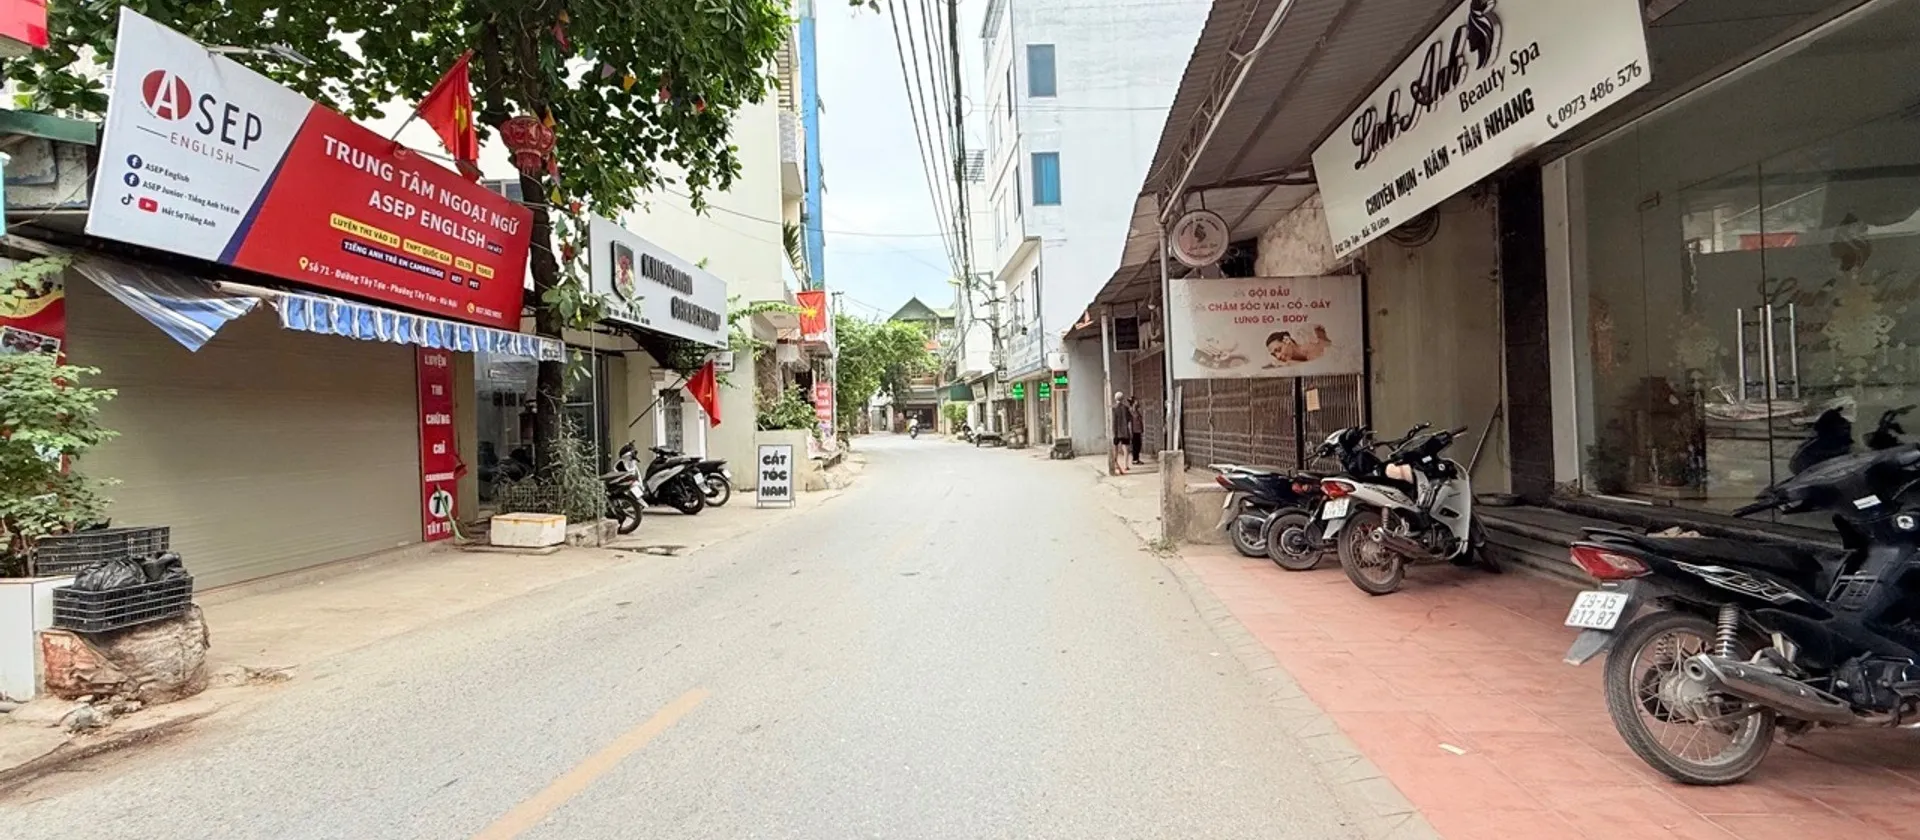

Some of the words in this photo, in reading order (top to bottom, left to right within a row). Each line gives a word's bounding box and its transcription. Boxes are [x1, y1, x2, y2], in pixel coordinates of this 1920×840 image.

[1459, 65, 1506, 113] Beauty
[1509, 41, 1541, 76] Spa
[1558, 94, 1587, 122] 0973
[1589, 77, 1614, 102] 486
[1617, 59, 1642, 87] 576
[142, 69, 263, 150] ASEP
[1351, 88, 1400, 170] Linh
[1400, 24, 1469, 132] Anh
[170, 132, 235, 165] ENGLISH
[1365, 182, 1396, 215] CHUYÊN
[1396, 167, 1418, 196] MỤN
[1456, 125, 1483, 156] TÀN
[1483, 87, 1535, 140] NHANG
[145, 163, 164, 173] ASEP
[164, 169, 190, 182] English
[323, 135, 394, 182] TRUNG
[399, 169, 435, 200] TÂM
[439, 188, 488, 224] NGOẠI
[490, 211, 520, 236] NGỮ
[142, 181, 162, 191] ASEP
[161, 187, 184, 198] Junior
[206, 199, 219, 209] Anh
[203, 217, 216, 227] Anh
[369, 190, 416, 220] ASEP
[419, 210, 486, 249] ENGLISH
[332, 217, 359, 233] LUYỆN
[359, 225, 373, 236] THI
[373, 227, 389, 242] VÀO
[405, 242, 422, 253] THPT
[308, 261, 320, 273] Số
[320, 265, 330, 276] 71
[335, 268, 359, 285] Đường
[344, 239, 368, 255] TIẾNG
[368, 248, 384, 261] ANH
[398, 257, 409, 268] EM
[409, 259, 445, 279] CAMBRIDGE
[1208, 301, 1237, 312] CHĂM
[1239, 299, 1260, 311] SÓC
[1263, 302, 1280, 310] VAI
[1310, 299, 1331, 309] GÁY
[1248, 288, 1267, 298] GỘI
[1234, 314, 1259, 324] LƯNG
[1262, 315, 1275, 324] EO
[1282, 314, 1308, 323] BODY
[762, 450, 787, 466] CẮT
[762, 468, 788, 481] TÓC
[761, 486, 788, 497] NAM
